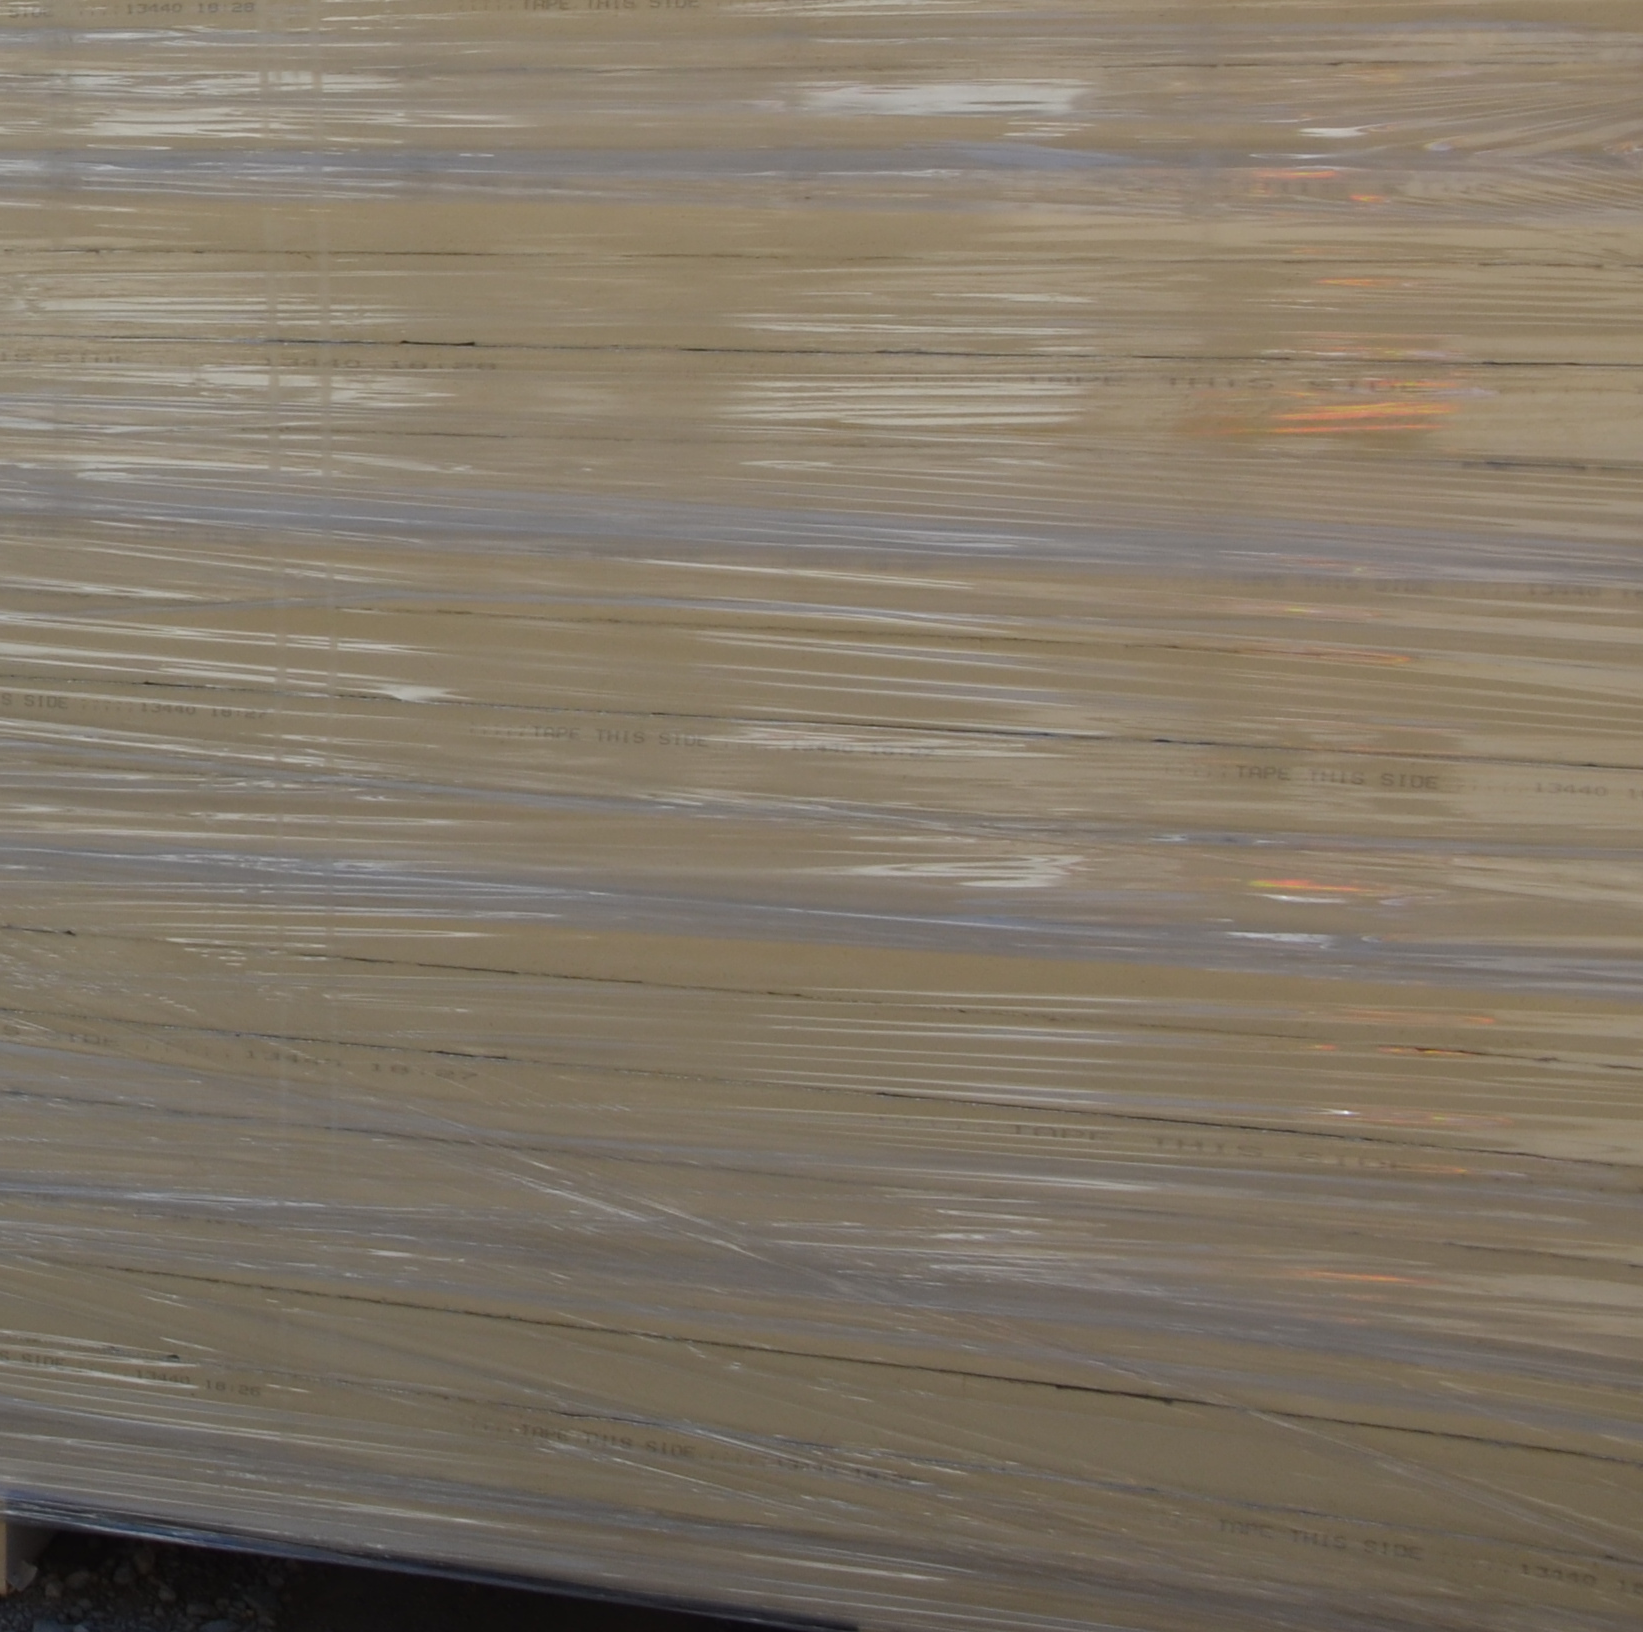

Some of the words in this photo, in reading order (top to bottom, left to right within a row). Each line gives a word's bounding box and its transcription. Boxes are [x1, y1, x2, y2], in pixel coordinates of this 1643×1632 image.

[126, 2, 183, 15] 13440
[23, 694, 68, 709] SIDE
[533, 725, 580, 740] TAPE
[596, 729, 645, 744] THIS
[658, 732, 710, 748] SIDE
[1237, 764, 1291, 781] TAPE
[1309, 769, 1366, 785] THIS
[1380, 772, 1441, 789] SIDE
[1536, 782, 1609, 797] 13440
[20, 1352, 65, 1367] SIDE
[645, 1440, 697, 1458] SIDE
[1292, 1529, 1347, 1550] THIS
[1363, 1539, 1424, 1560] SIDE
